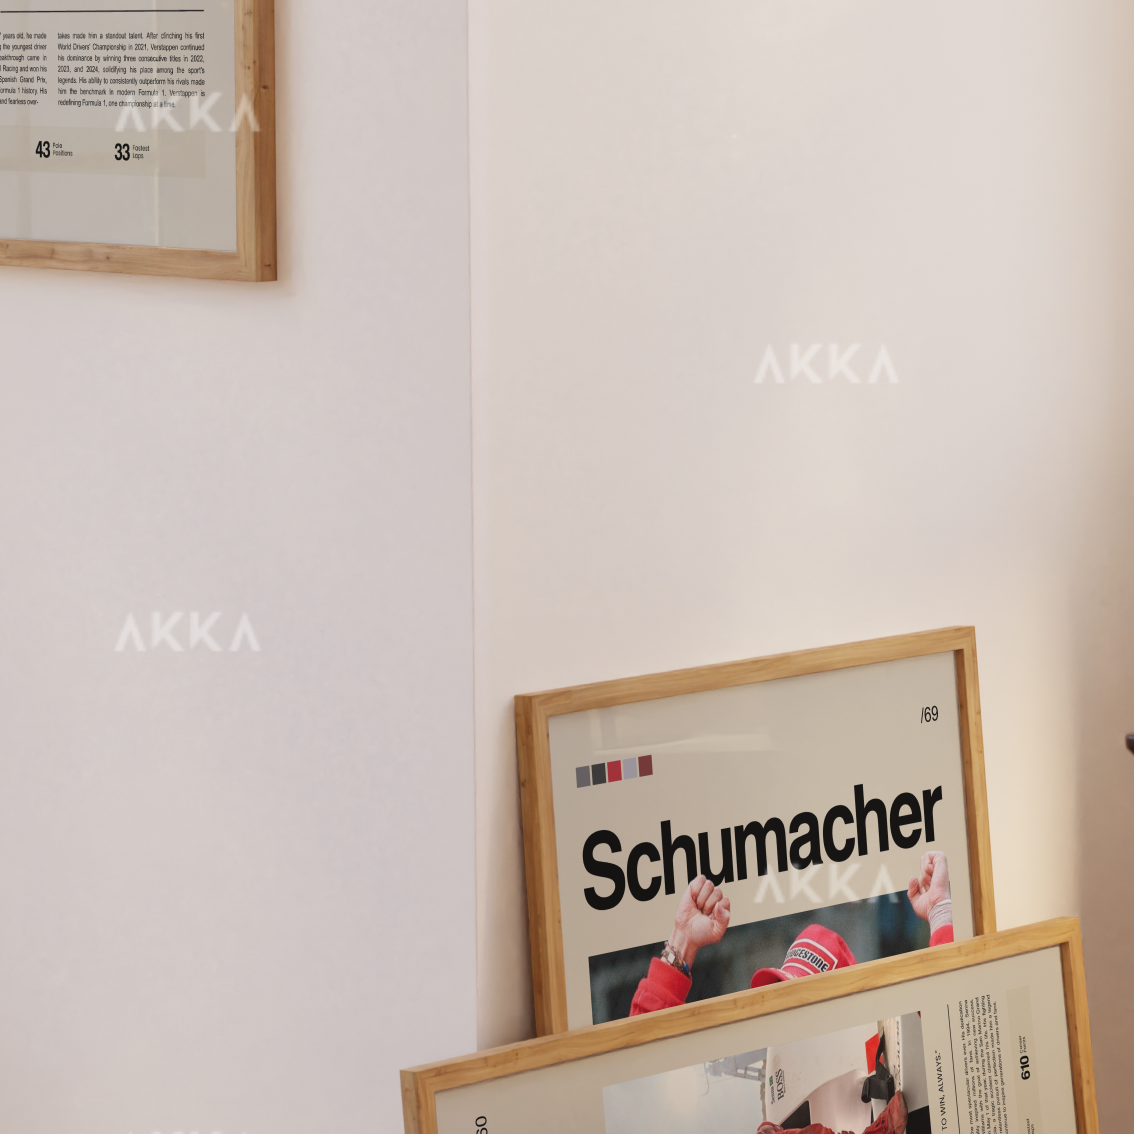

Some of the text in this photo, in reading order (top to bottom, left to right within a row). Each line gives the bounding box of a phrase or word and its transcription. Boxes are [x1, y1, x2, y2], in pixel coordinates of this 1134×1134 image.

[35, 140, 51, 158] 43
[114, 142, 131, 161] 33
[132, 144, 150, 152] Fastest
[920, 704, 940, 724] /69
[582, 784, 943, 911] Schumacher
[1019, 1055, 1031, 1079] 610
[775, 1068, 785, 1100] BOSS
[938, 1093, 947, 1115] WIN,
[940, 1117, 948, 1131] TO
